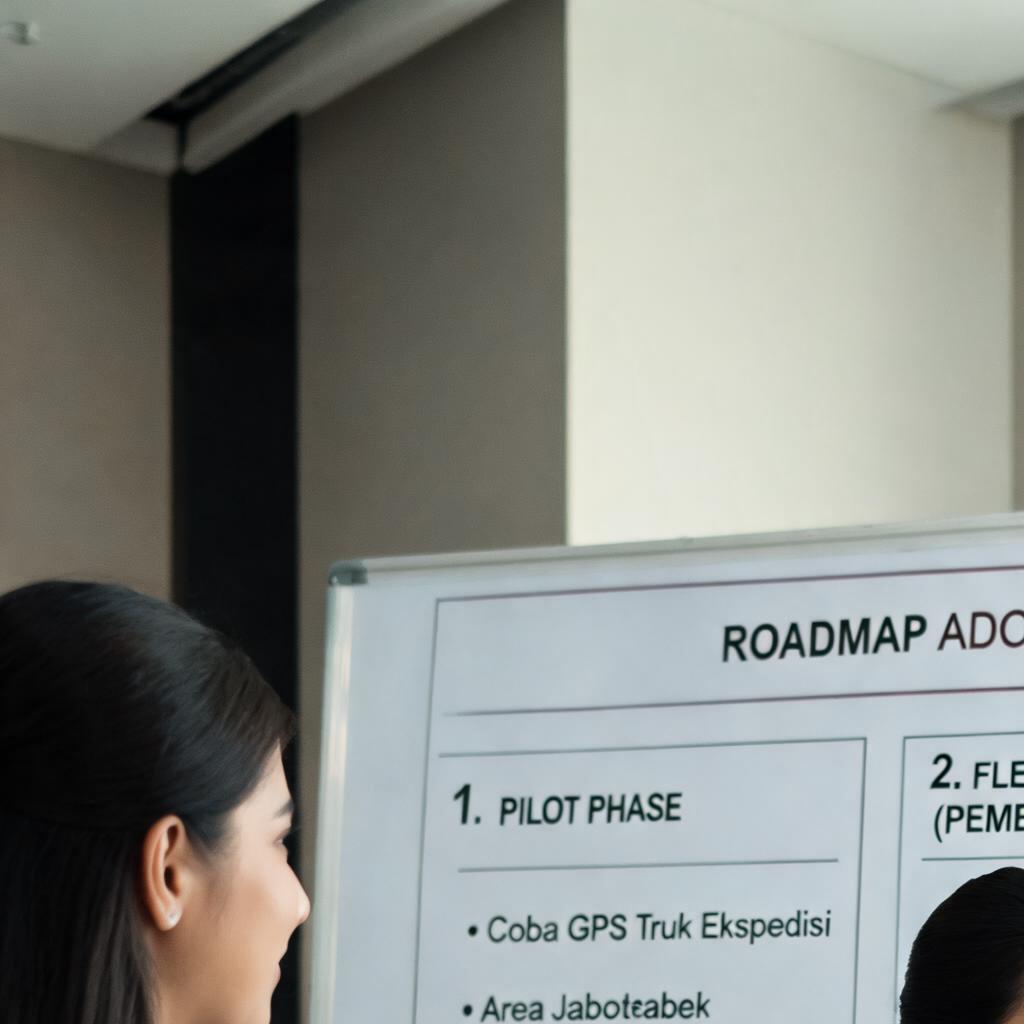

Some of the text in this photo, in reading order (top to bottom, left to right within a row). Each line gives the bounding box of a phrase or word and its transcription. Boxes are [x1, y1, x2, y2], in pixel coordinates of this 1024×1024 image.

[721, 613, 928, 663] ROADMAP
[929, 752, 963, 791] 2.
[452, 782, 684, 827] 1. PILOT PHASE
[486, 909, 832, 946] Coba GPS Truk Ekspedisi
[480, 995, 545, 1024] Area
